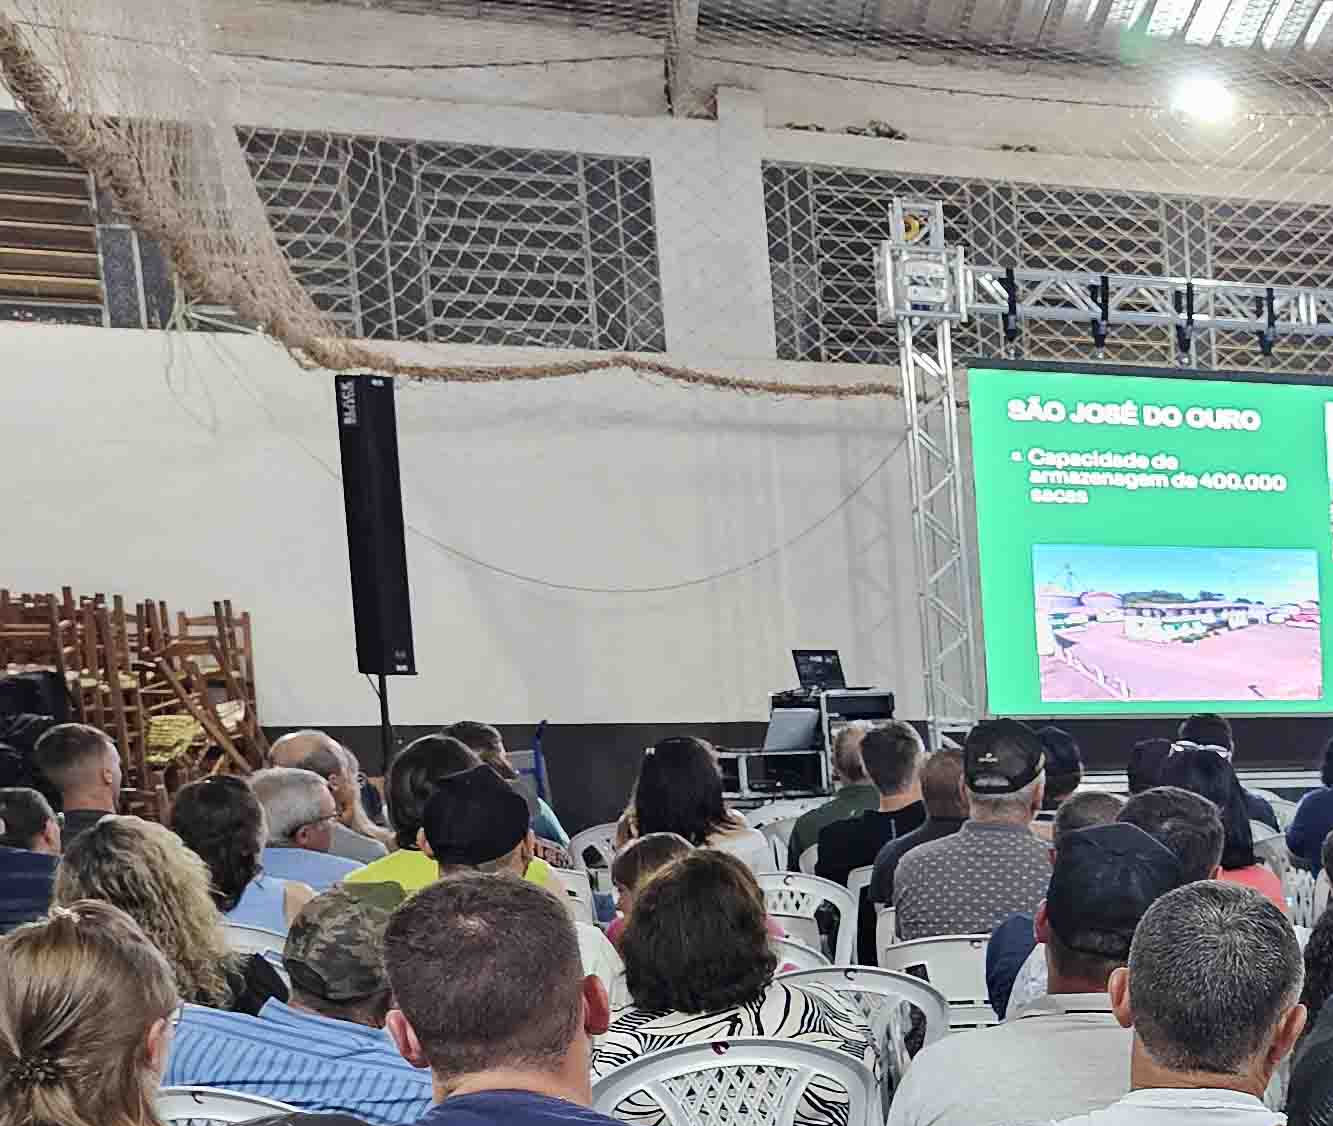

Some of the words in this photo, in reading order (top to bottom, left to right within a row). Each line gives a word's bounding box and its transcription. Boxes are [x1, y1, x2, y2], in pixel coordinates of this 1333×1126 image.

[1008, 395, 1066, 422] SÃO
[1069, 400, 1139, 425] JOSÉ
[1143, 405, 1183, 427] DO
[1185, 406, 1261, 431] OURO
[1027, 448, 1149, 469] Capacidade
[1151, 455, 1179, 471] de
[1029, 470, 1170, 490] armazenagem
[1171, 472, 1199, 489] de
[1200, 472, 1288, 492] 400.000
